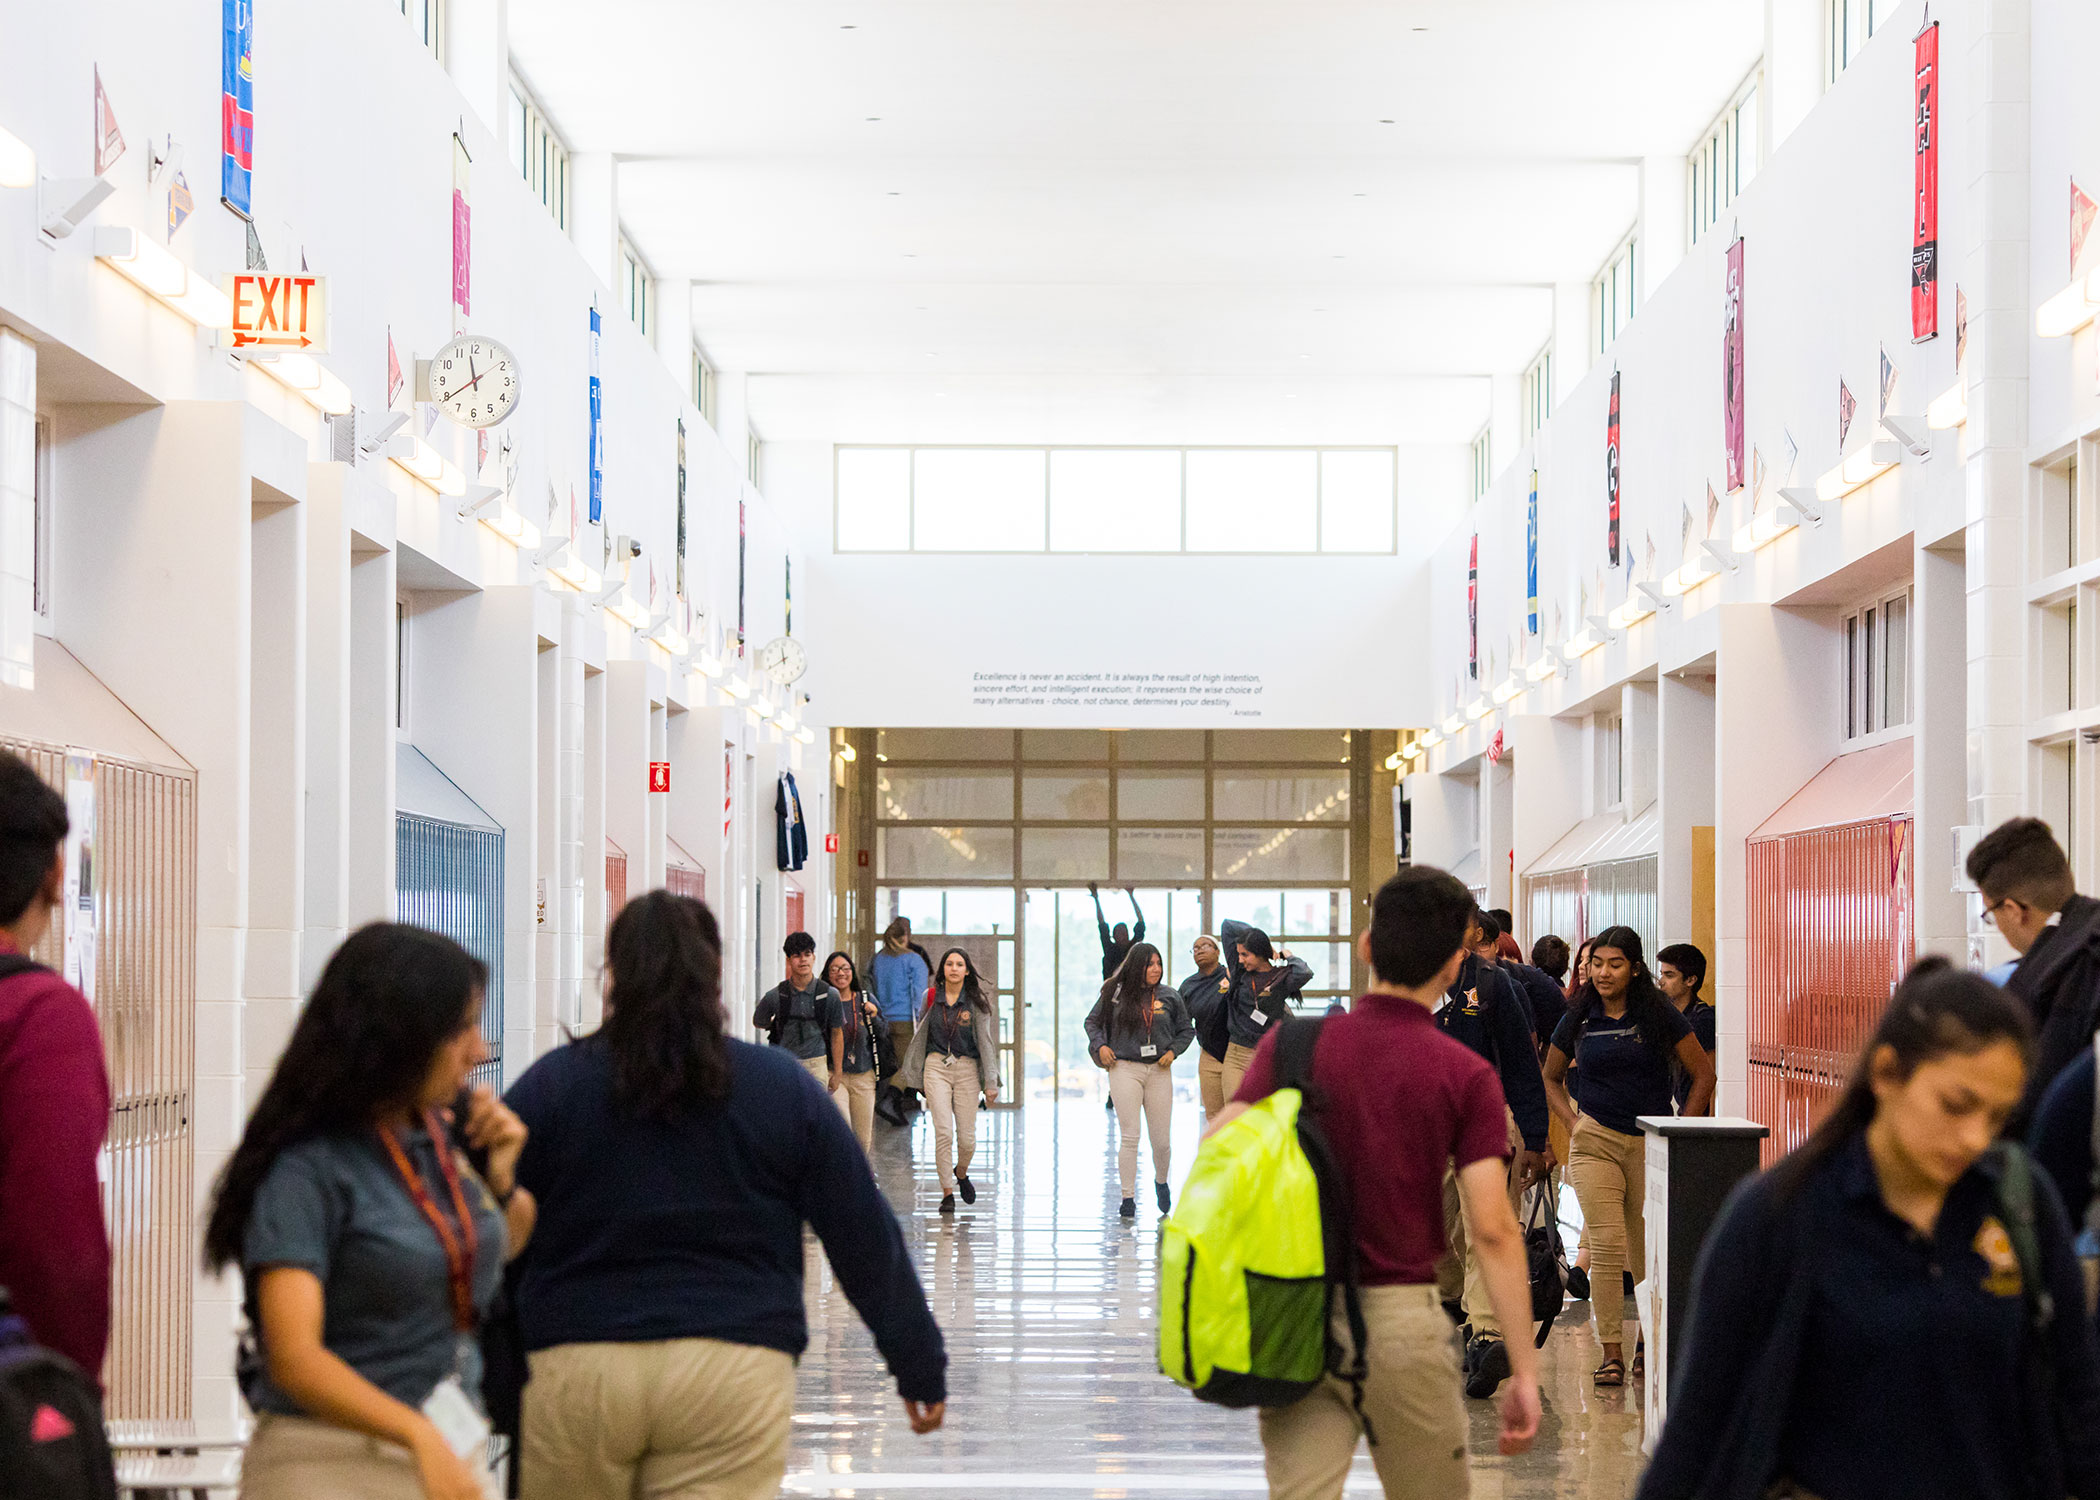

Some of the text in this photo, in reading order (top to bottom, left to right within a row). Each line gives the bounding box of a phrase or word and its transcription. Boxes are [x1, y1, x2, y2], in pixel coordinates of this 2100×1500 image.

[232, 275, 315, 332] EXIT
[455, 348, 463, 358] 11
[470, 344, 480, 354] 12
[443, 359, 453, 370] 10
[499, 361, 506, 371] 2
[439, 376, 446, 386] 9
[504, 377, 511, 387] 3
[443, 391, 450, 402] 8
[499, 393, 506, 403] 4
[455, 403, 462, 413] 7
[470, 408, 477, 418] 6
[487, 404, 494, 414] 5
[973, 672, 1017, 682] Excellence
[1019, 672, 1026, 682] is
[1029, 674, 1052, 682] never
[1054, 674, 1064, 682] an
[1104, 673, 1111, 682] It
[1113, 673, 1120, 682] is
[1122, 673, 1150, 684] always
[1152, 674, 1165, 683] the
[1166, 674, 1191, 683] result
[1192, 674, 1201, 683] of
[1203, 674, 1220, 684] high
[973, 685, 1003, 693] sincere
[1031, 685, 1047, 693] and
[1049, 685, 1090, 695] intelligent
[1136, 686, 1142, 694] it
[1143, 686, 1187, 695] represents
[1189, 686, 1202, 694] the
[1204, 686, 1222, 694] wise
[1225, 686, 1252, 694] choice
[1254, 686, 1263, 694] of
[973, 698, 995, 706] many
[997, 697, 1045, 705] alternatives
[1132, 698, 1178, 706] determines
[1180, 699, 1199, 708] your
